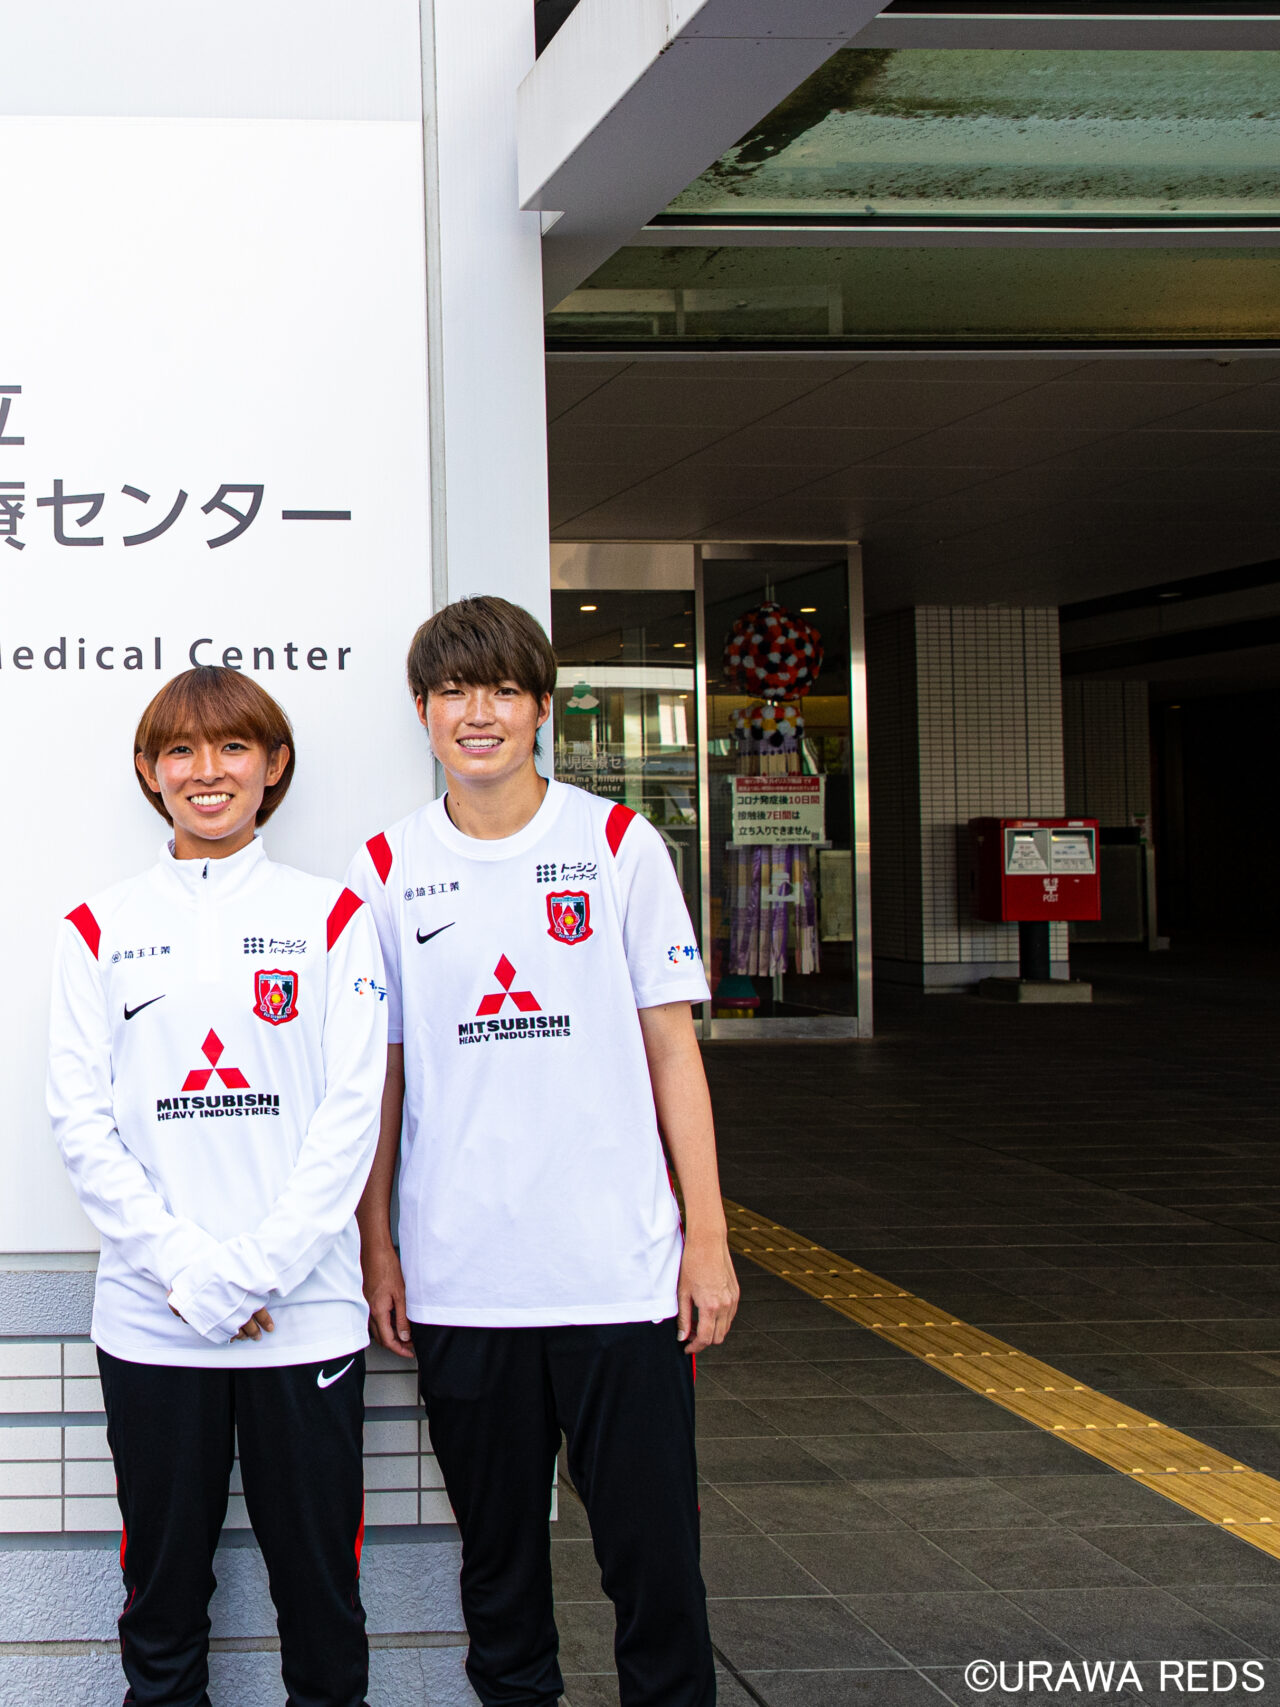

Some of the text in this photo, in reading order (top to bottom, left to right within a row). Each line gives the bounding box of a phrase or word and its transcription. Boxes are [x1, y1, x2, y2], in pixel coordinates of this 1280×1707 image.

[189, 638, 351, 671] Center
[561, 862, 597, 873] トーシン
[269, 938, 306, 948] トーシン
[458, 1015, 570, 1036] MITSUBISHI
[459, 1028, 571, 1045] HEAVY INDUSTRIES
[156, 1094, 280, 1112] MITSUBISHI
[157, 1107, 280, 1121] HEAVY INDUSTRIES
